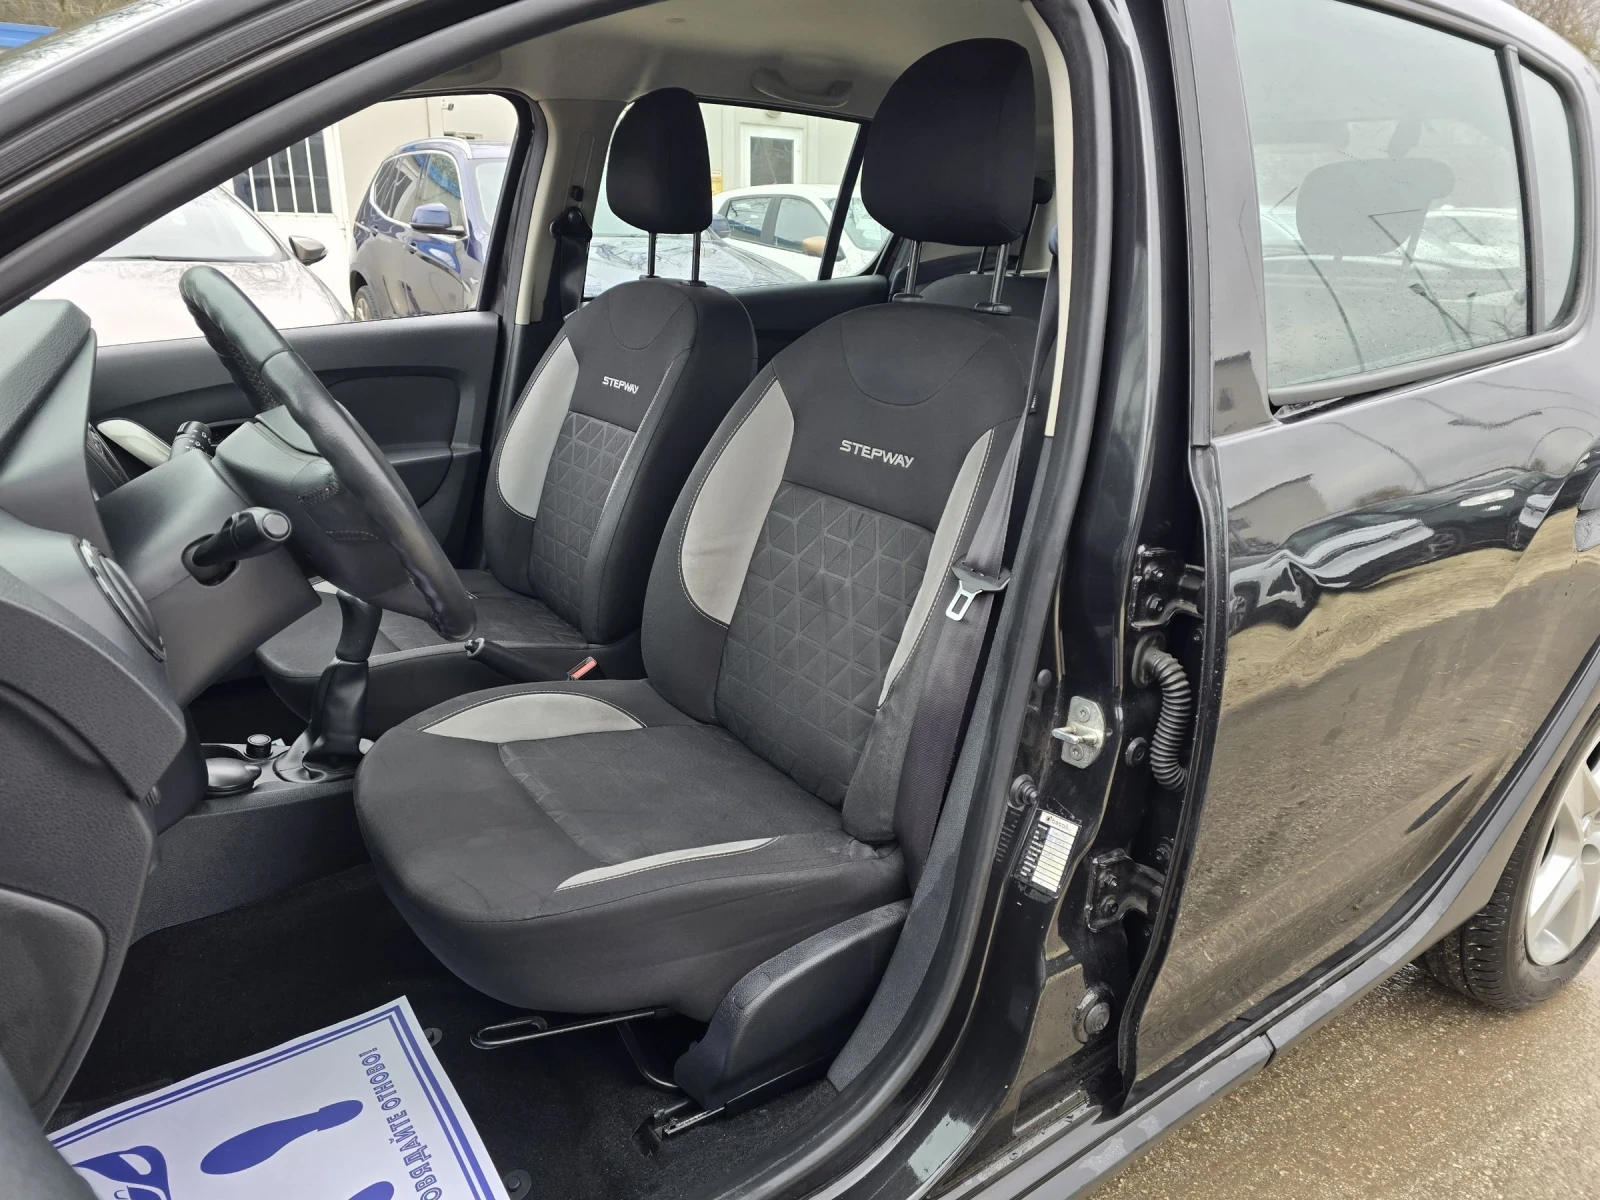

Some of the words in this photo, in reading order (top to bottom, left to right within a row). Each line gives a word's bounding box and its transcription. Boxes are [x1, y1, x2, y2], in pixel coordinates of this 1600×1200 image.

[602, 375, 640, 394] STEPWAY
[839, 439, 915, 469] STEPWAY
[358, 1047, 402, 1111] ОТНОВО!
